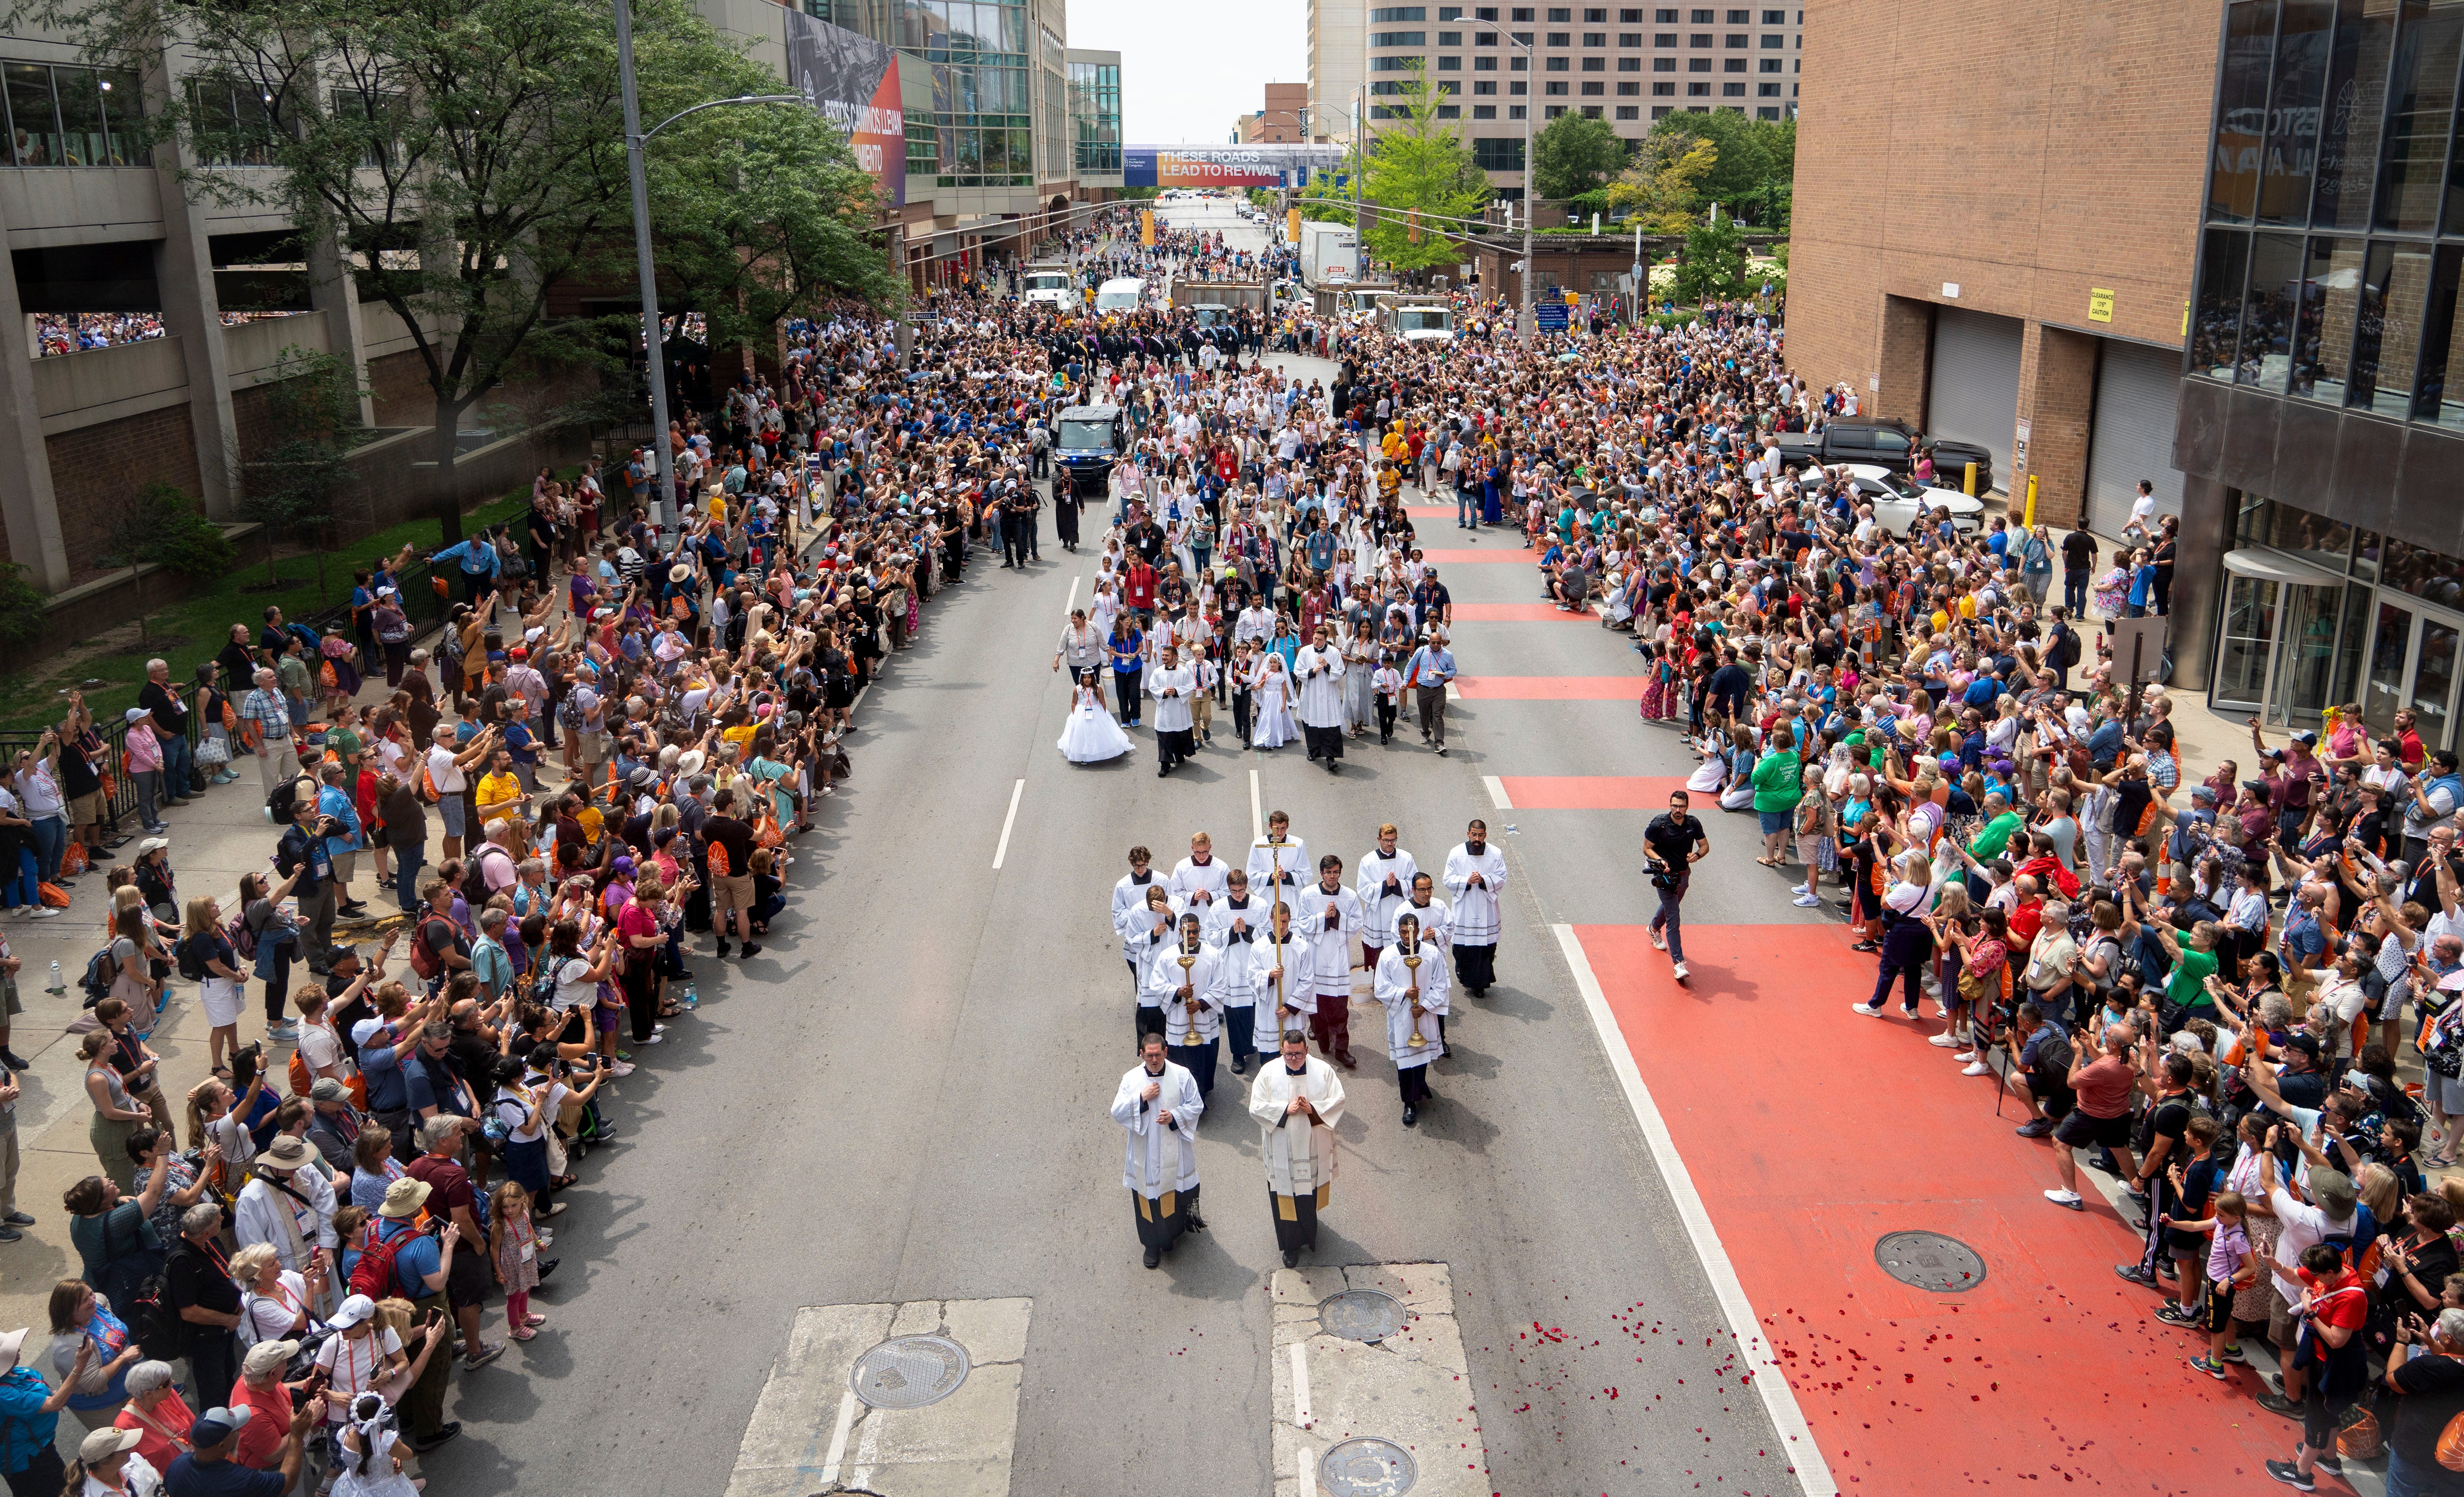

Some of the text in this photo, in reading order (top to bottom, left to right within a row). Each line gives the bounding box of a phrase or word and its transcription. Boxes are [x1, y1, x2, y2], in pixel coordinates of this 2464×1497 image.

[850, 103, 880, 134] CAMINOS
[881, 108, 902, 136] LLEVAN
[1161, 151, 1260, 162] THESE ROADS
[1163, 165, 1280, 176] LEAD TO REVIVAL
[2091, 292, 2113, 301] CLEARANCE
[2092, 308, 2109, 316] CAUTION
[938, 1349, 956, 1368] Thermal
[935, 1369, 957, 1388] Energy
[2281, 1470, 2296, 1479] HOKA
